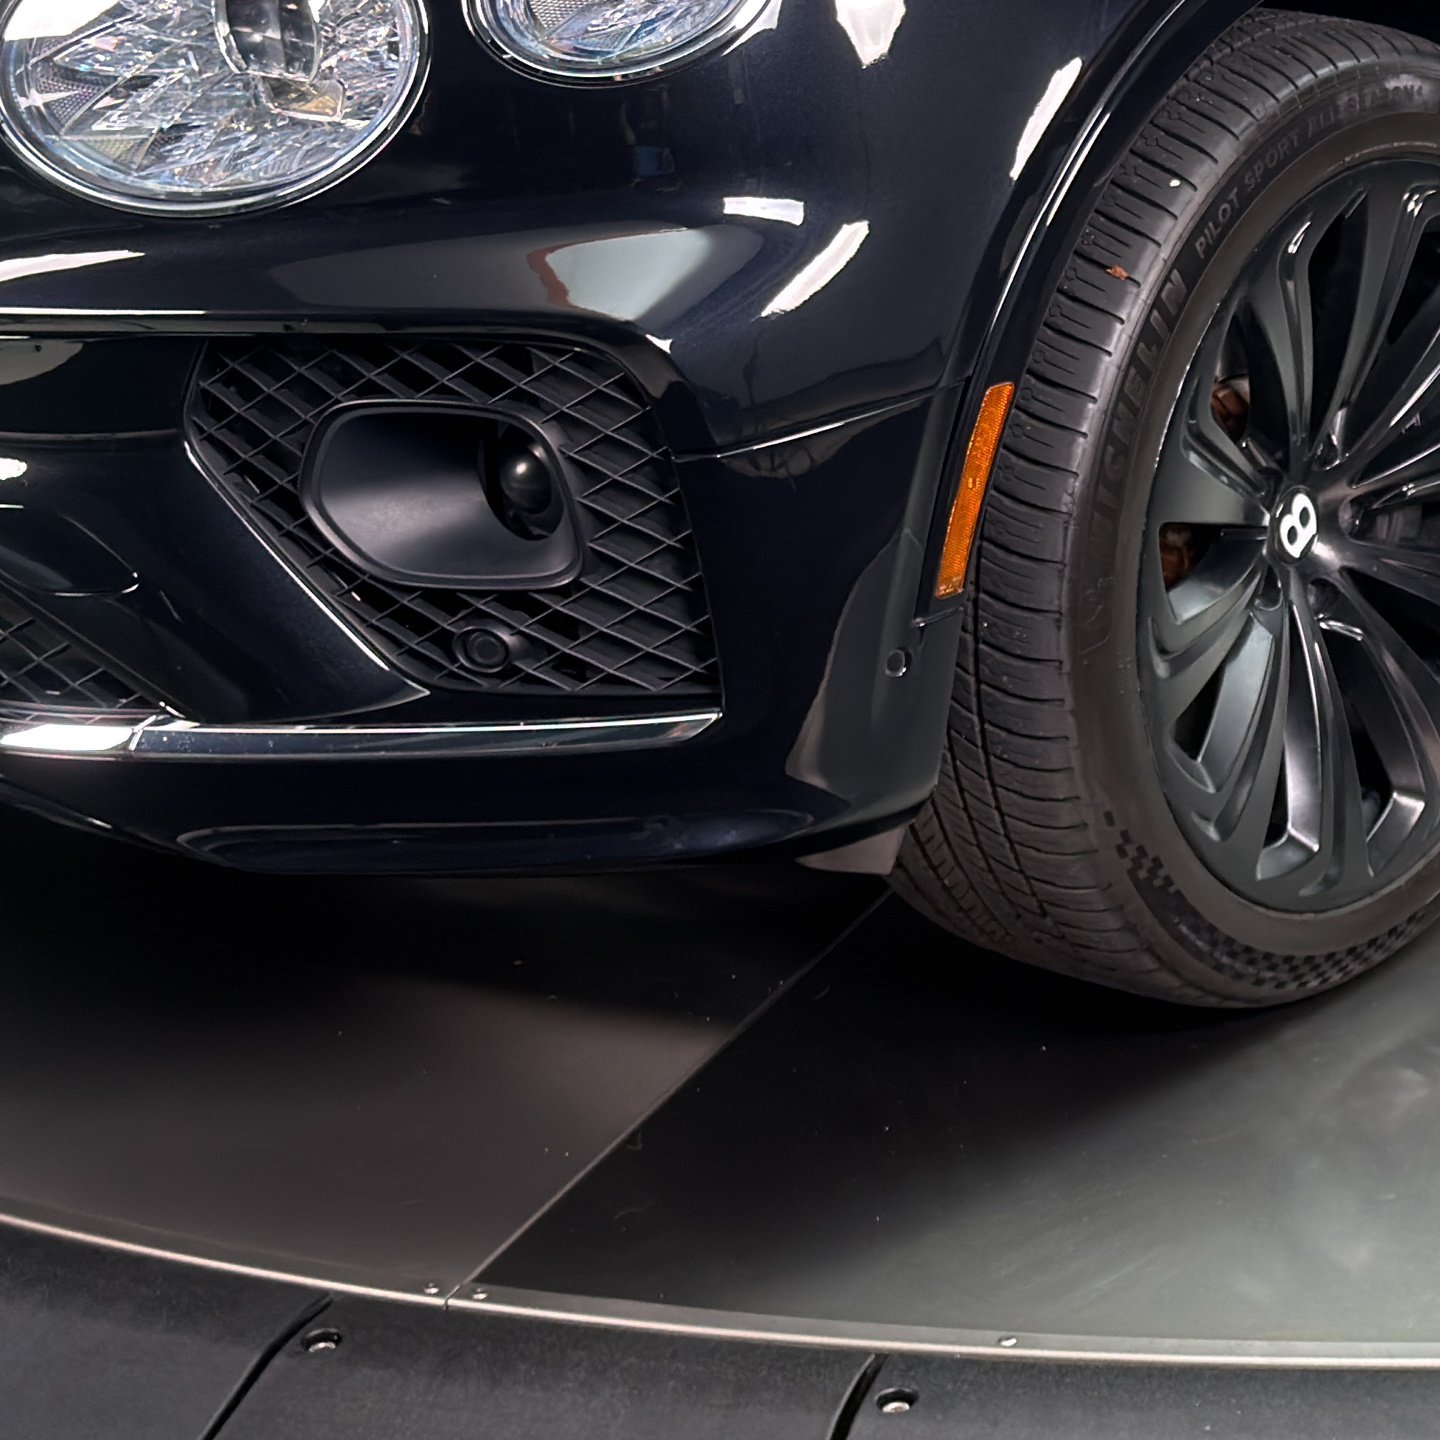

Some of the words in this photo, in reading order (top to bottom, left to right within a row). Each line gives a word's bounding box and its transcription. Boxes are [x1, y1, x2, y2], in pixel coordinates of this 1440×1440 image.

[1194, 186, 1245, 260] PILOT
[1244, 128, 1301, 192] SPORT
[1279, 492, 1318, 559] B
